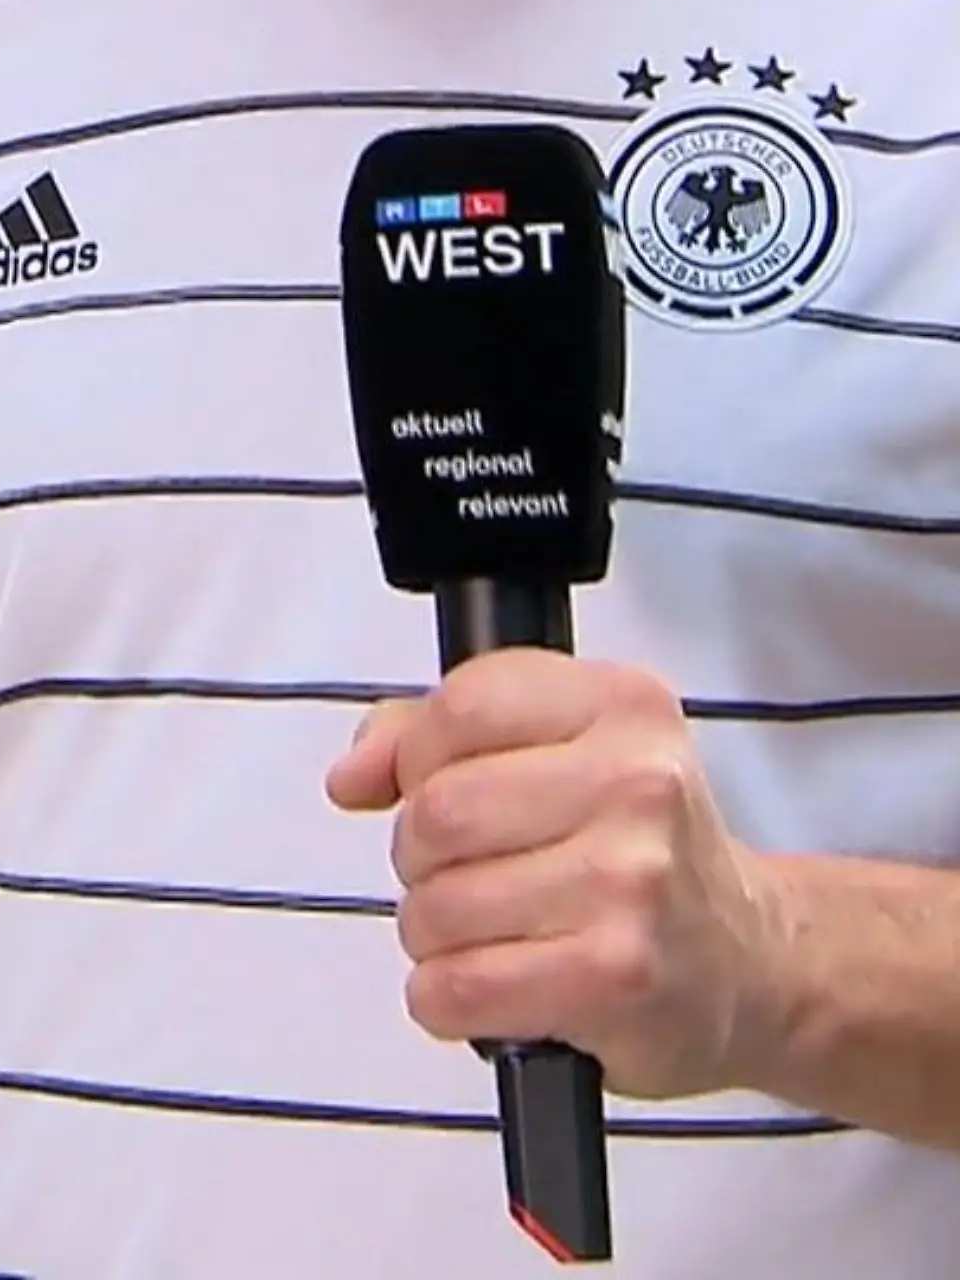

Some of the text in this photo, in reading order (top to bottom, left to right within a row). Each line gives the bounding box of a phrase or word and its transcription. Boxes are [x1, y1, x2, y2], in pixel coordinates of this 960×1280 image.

[660, 131, 792, 177] DEUTSCHER
[376, 222, 566, 283] WEST
[391, 408, 485, 439] aktuell
[424, 446, 535, 482] regional
[458, 488, 570, 519] relevant
